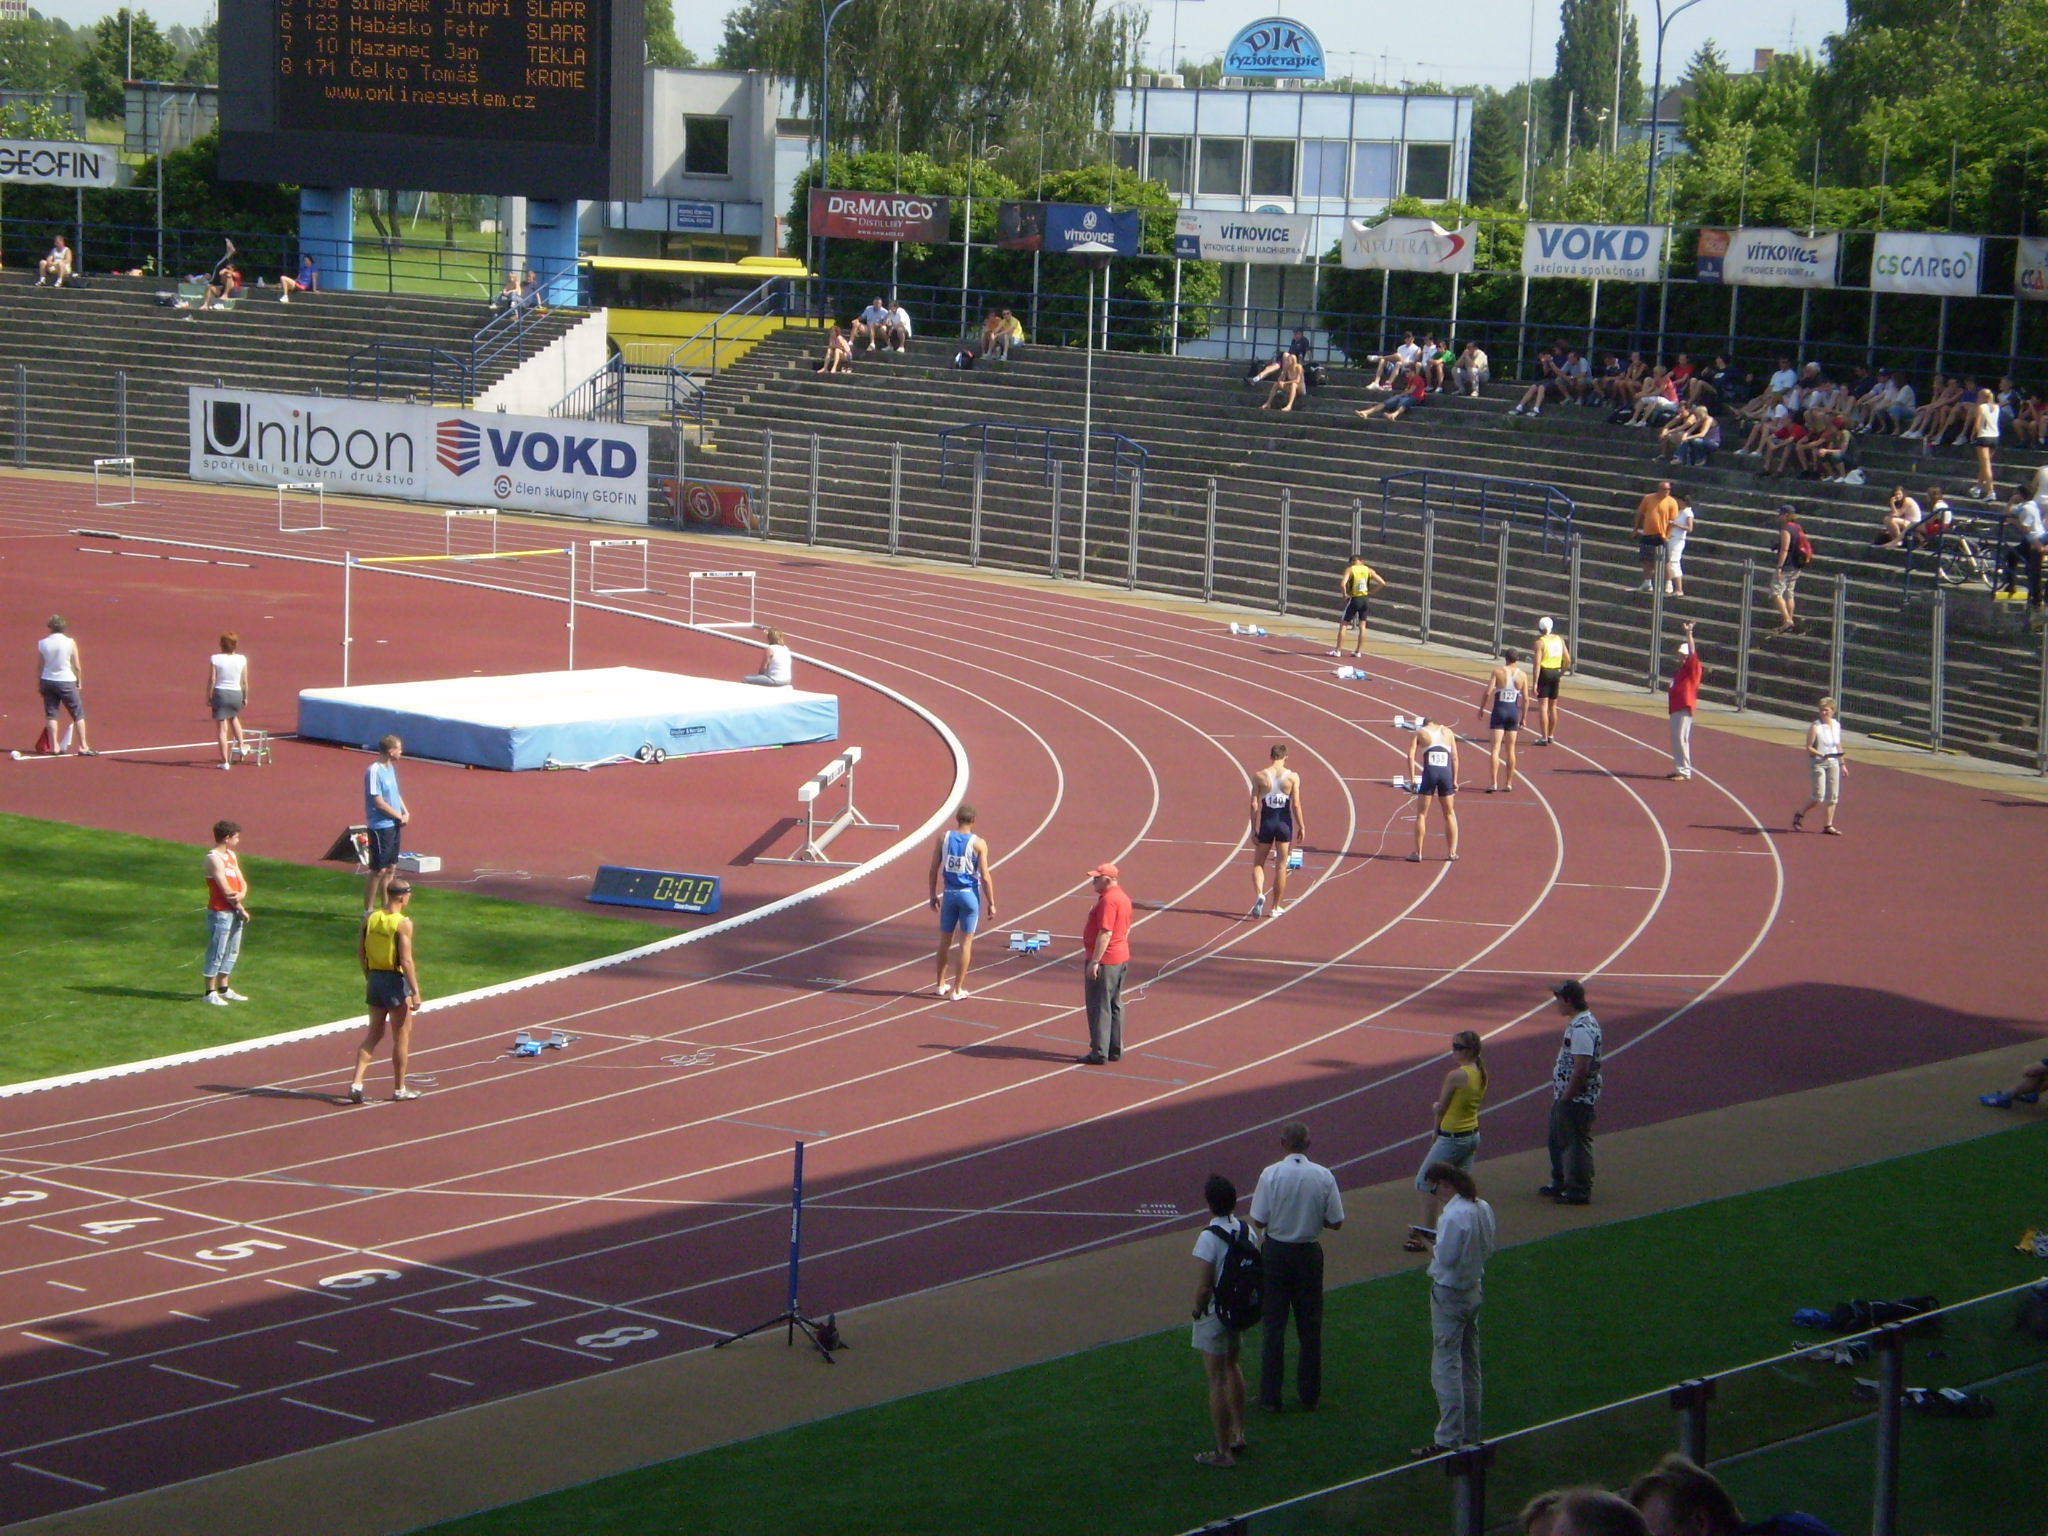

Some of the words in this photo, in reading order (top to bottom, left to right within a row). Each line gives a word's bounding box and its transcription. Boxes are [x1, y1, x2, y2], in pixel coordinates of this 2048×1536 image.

[526, 0, 587, 19] SLAPR
[280, 12, 292, 30] 6
[304, 13, 339, 32] 123
[350, 14, 431, 36] Habásko
[526, 22, 586, 42] SLAPR
[281, 34, 292, 52] 7
[315, 36, 338, 54] 10
[350, 38, 430, 58] Mazanec
[444, 42, 479, 60] Jan
[526, 45, 586, 66] TEKLA
[1229, 52, 1320, 69] fyzioterapie
[280, 57, 292, 75] 8
[304, 58, 336, 76] 171
[420, 63, 479, 83] Tomáš
[526, 68, 586, 88] KROME
[324, 84, 537, 108] www.onlinesystem.cz
[0, 148, 100, 180] GEOFIN
[1064, 228, 1115, 243] VÍTKOVICE
[1220, 223, 1290, 242] VÍTKOVICE
[1537, 227, 1650, 261] VOKD
[1747, 241, 1819, 264] VÍTKOVICE
[203, 399, 416, 474] Unibon
[487, 428, 638, 479] VOKD
[283, 467, 290, 476] a
[351, 470, 414, 486] družstvo
[515, 481, 541, 496] člen
[544, 486, 589, 502] skupiny
[592, 489, 637, 506] GEOFIN
[948, 856, 962, 869] 64
[80, 1217, 165, 1235] 4
[195, 1239, 287, 1261] 5
[318, 1269, 402, 1290] 6
[435, 1294, 537, 1315] 7
[576, 1326, 659, 1349] 8
